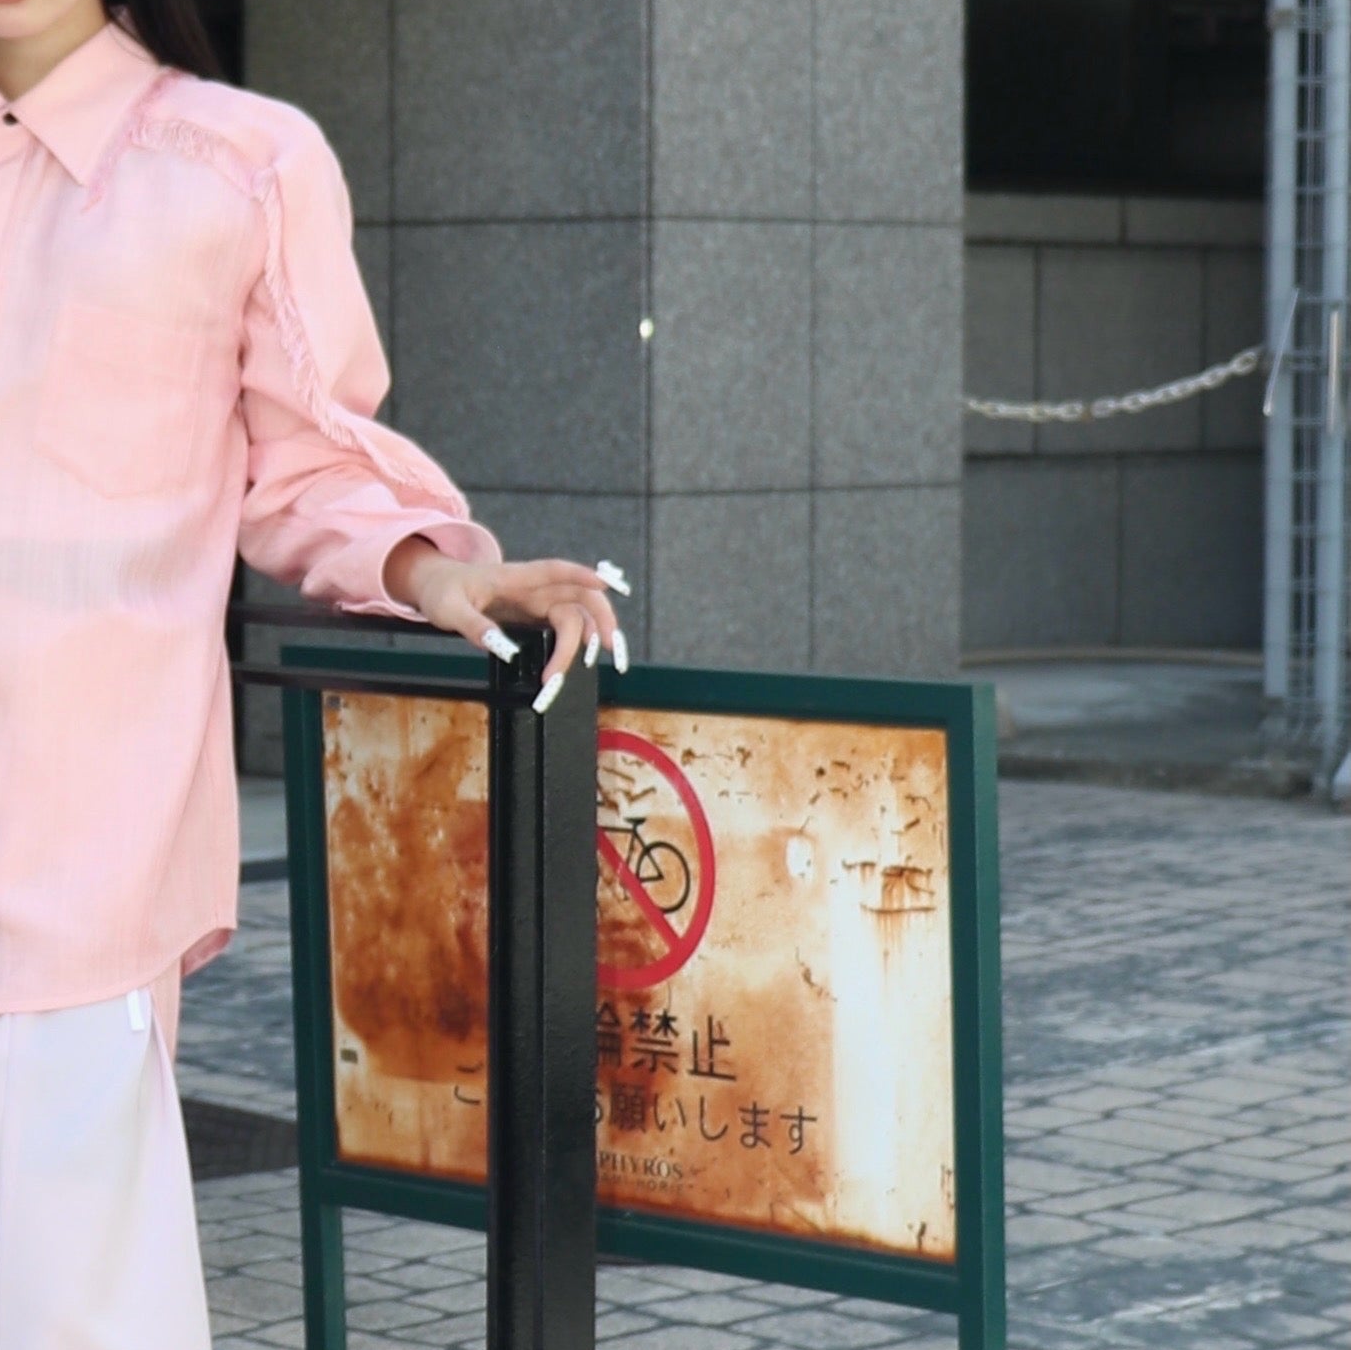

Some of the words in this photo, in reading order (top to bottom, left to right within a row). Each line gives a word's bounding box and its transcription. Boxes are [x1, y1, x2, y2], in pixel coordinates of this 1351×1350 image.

[597, 1002, 738, 1082] 輪禁止
[596, 1081, 818, 1156] 願いします
[599, 1152, 684, 1180] PHYROS
